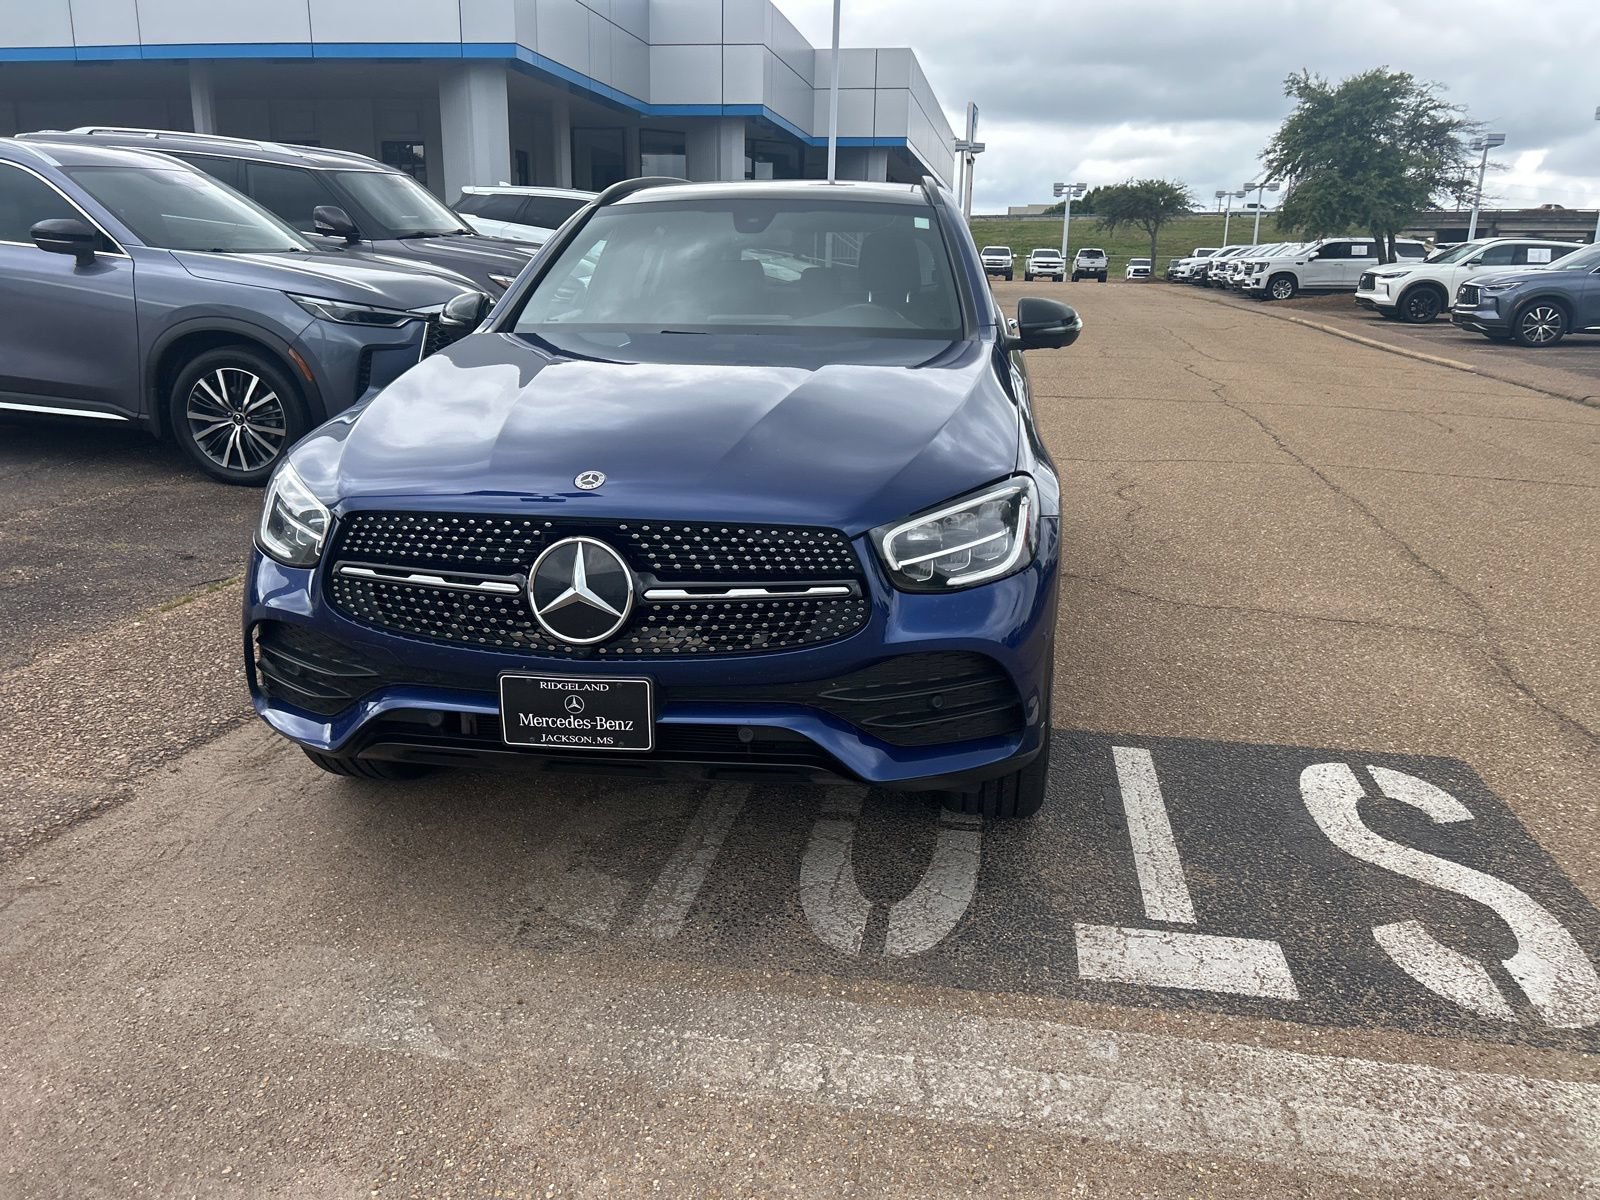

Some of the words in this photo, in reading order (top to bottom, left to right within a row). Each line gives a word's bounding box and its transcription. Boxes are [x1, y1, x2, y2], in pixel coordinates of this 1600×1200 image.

[539, 681, 609, 692] RIDGELAND
[518, 712, 634, 731] Mercedes-Benz
[596, 736, 614, 745] MS
